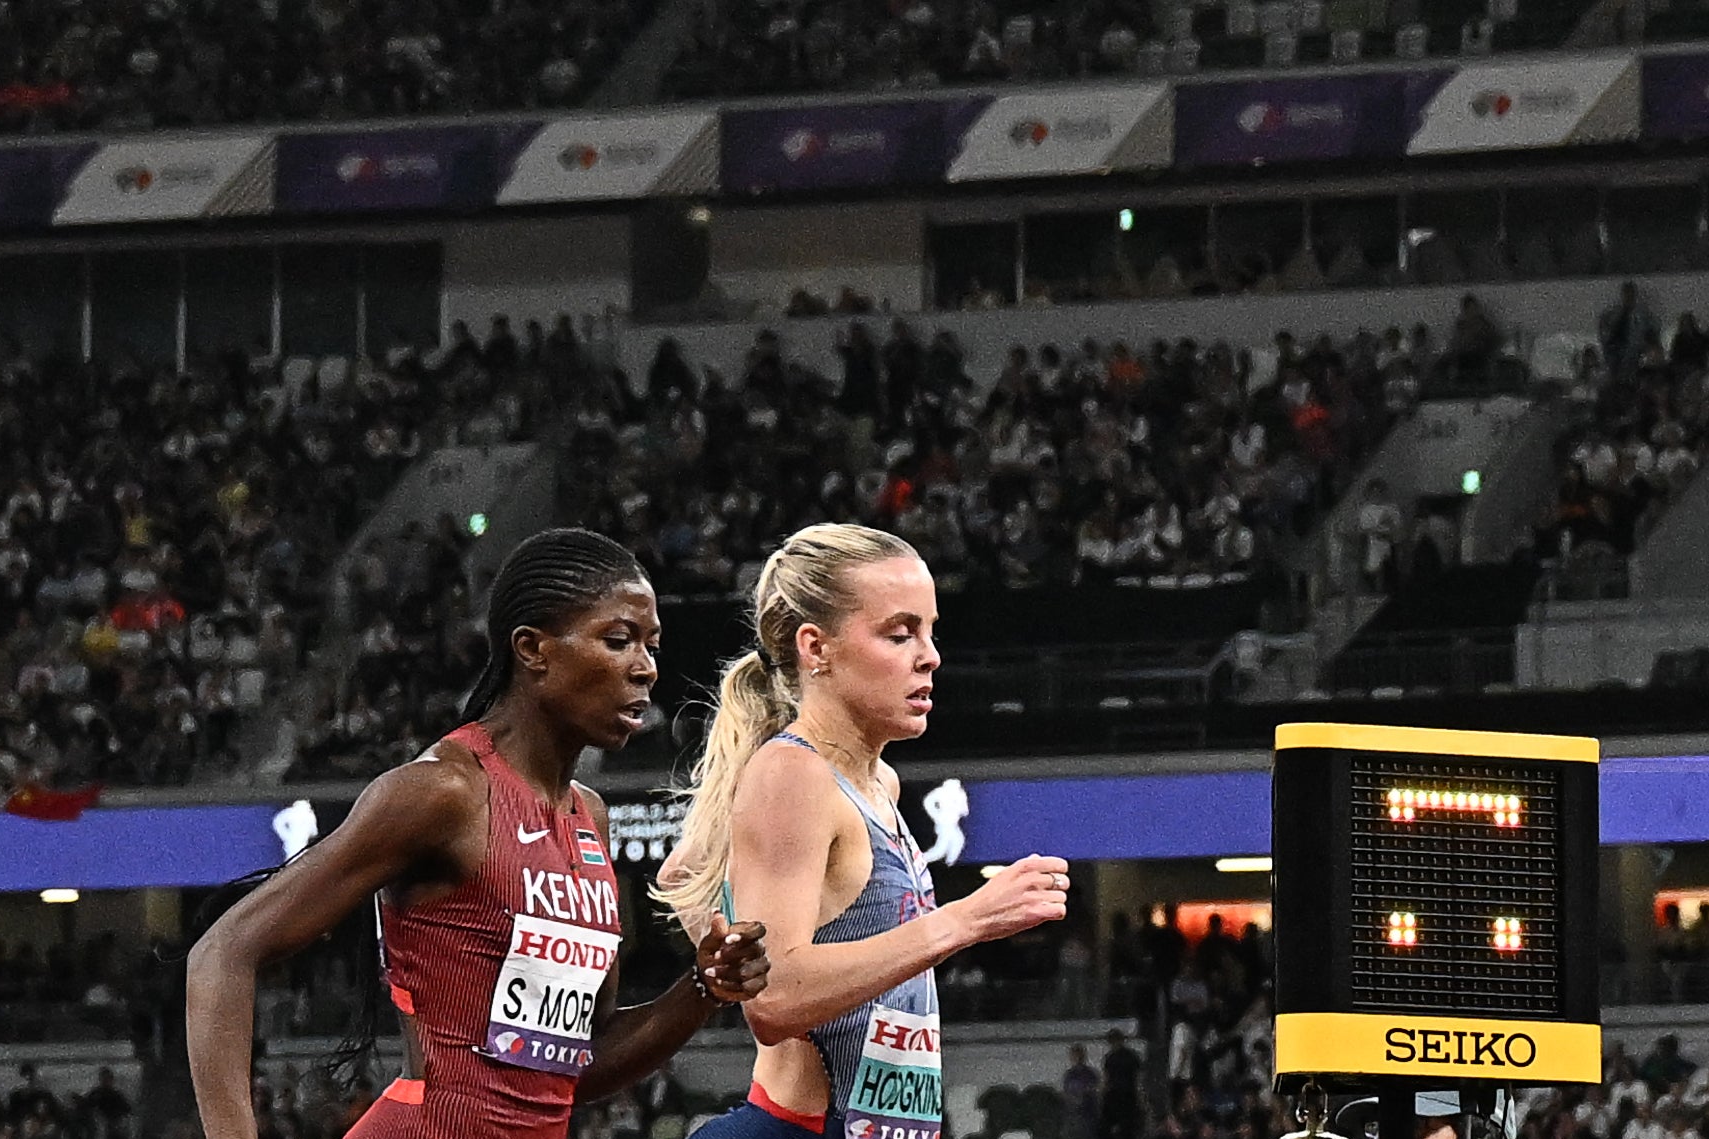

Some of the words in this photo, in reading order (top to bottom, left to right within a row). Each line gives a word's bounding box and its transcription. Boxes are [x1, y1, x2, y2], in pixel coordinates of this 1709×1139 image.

[522, 867, 618, 926] KENYA
[502, 978, 527, 1022] S.
[537, 985, 593, 1035] MOR
[1385, 1027, 1537, 1068] SEIKO
